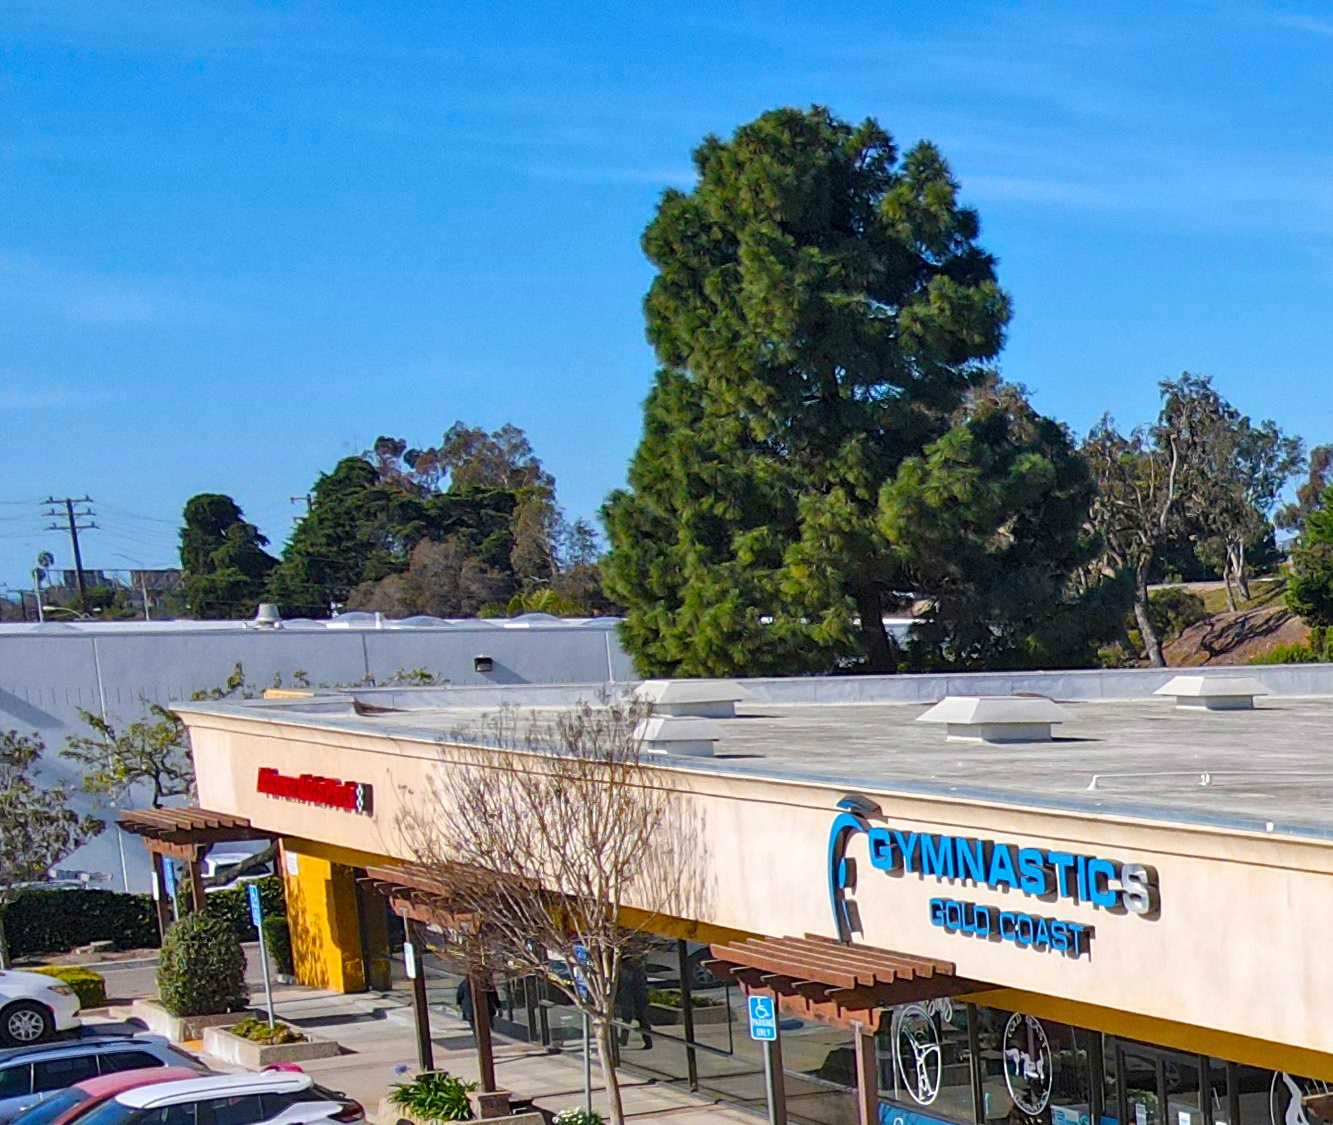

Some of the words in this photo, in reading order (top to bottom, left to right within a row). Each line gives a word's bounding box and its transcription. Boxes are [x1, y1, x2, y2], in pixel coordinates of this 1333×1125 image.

[868, 827, 1151, 915] GYMNASTICS
[929, 897, 991, 936] GOLD
[1000, 911, 1086, 955] COAST
